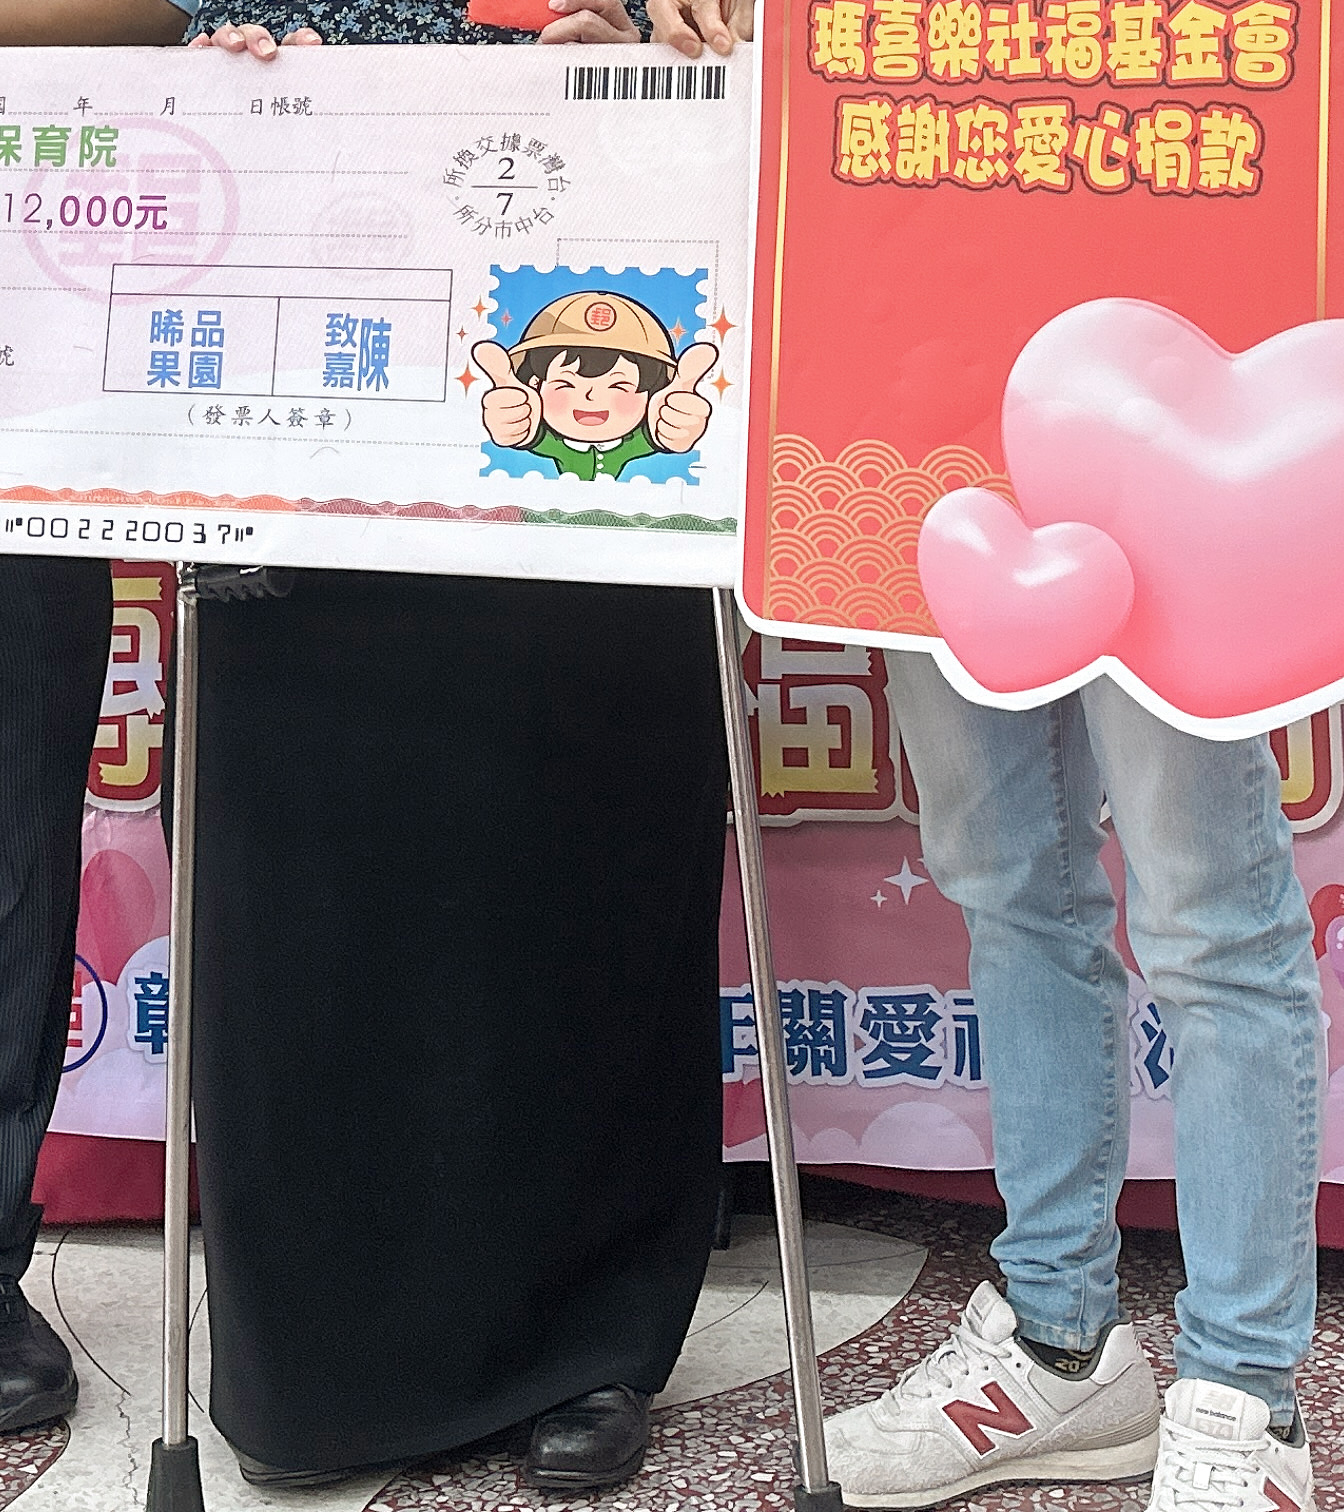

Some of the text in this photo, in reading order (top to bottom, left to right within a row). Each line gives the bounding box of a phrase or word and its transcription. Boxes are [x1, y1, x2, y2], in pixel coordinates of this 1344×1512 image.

[72, 95, 94, 118] 年
[159, 95, 177, 117] 月
[837, 98, 1260, 192] 感謝您愛心捐款
[497, 156, 516, 180] 2
[495, 192, 514, 216] 7
[939, 1378, 1038, 1459] N
